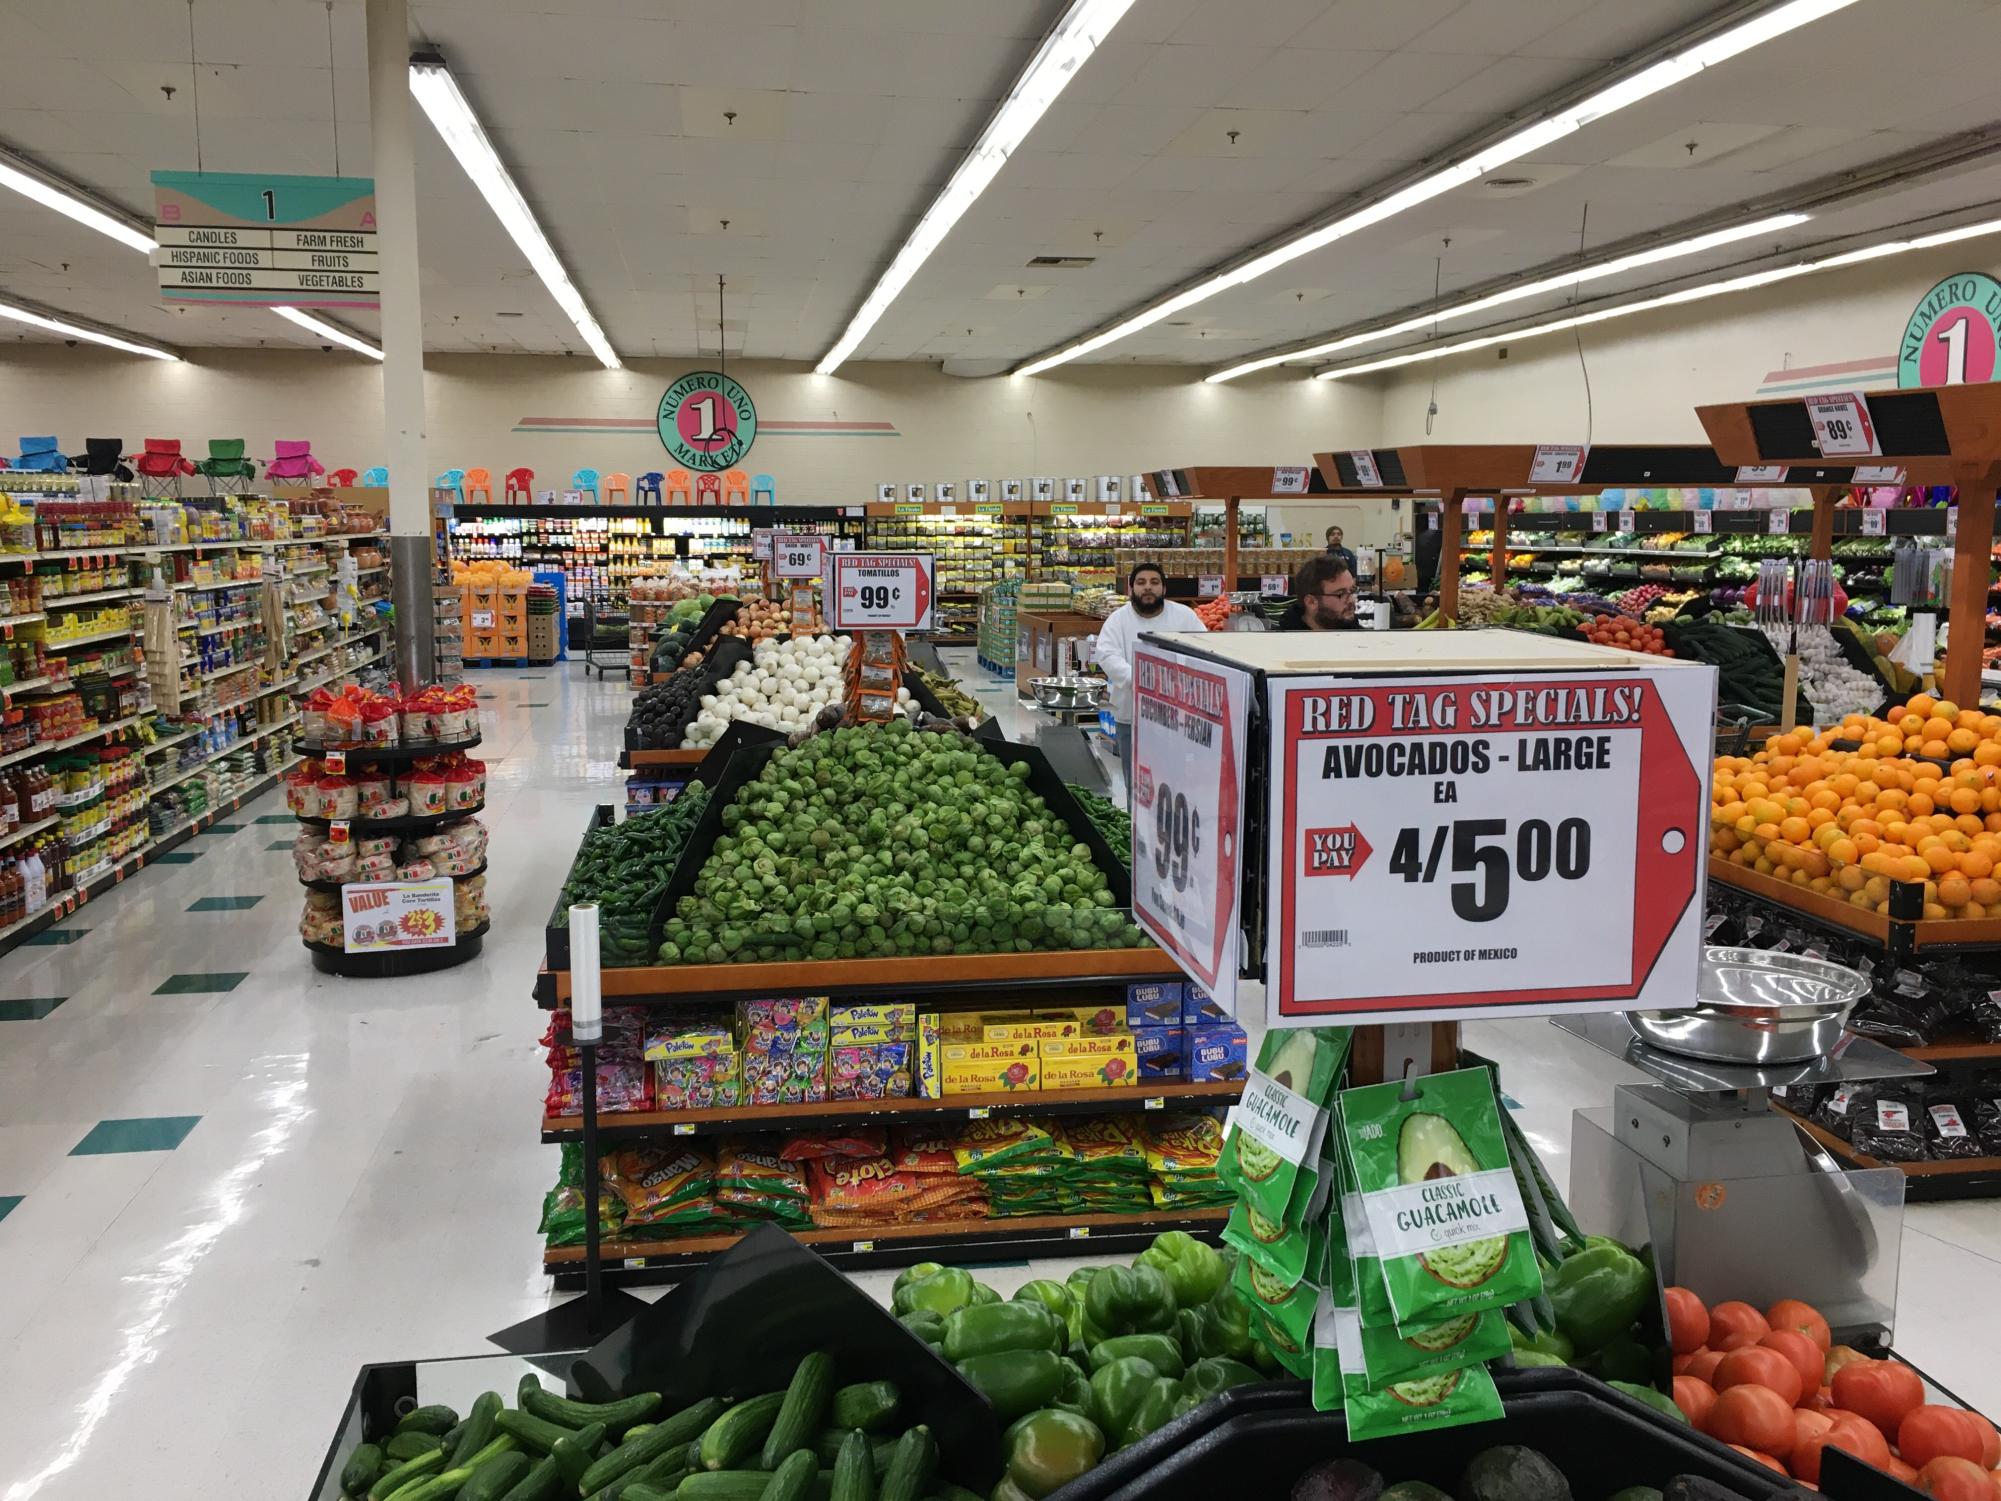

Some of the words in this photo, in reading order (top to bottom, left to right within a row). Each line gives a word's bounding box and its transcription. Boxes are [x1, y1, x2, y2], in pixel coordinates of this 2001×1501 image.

[162, 204, 181, 220] B
[262, 189, 275, 220] 1
[360, 211, 376, 226] A
[188, 231, 237, 244] CANDLES
[296, 234, 327, 247] FARM
[330, 235, 364, 248] FRESH
[171, 250, 220, 264] HISPANIC
[223, 252, 259, 264] FOODS
[311, 255, 349, 268] FRUITS
[180, 271, 213, 284] ASIAN
[216, 272, 252, 285] FOODS
[298, 274, 364, 288] VEGETABLES
[1904, 280, 1976, 364] NUMERO
[1937, 316, 1968, 385] 1
[663, 377, 719, 421] NUMERO
[726, 385, 752, 421] UNO
[690, 397, 724, 441] 1
[674, 443, 740, 467] MARKET
[842, 559, 858, 567] RED
[860, 559, 876, 567] TAG
[858, 569, 900, 577] TOMATILLOS
[1302, 694, 1375, 733] RED
[1388, 691, 1457, 730] TAG
[1470, 686, 1643, 727] SPECIALS!
[1322, 739, 1490, 780] AVOCADOS
[1517, 735, 1611, 772] LARGE
[1433, 781, 1458, 804] EA
[1312, 832, 1356, 850] YOU
[1312, 850, 1353, 870] PAY
[349, 891, 390, 913] VALUE
[1413, 950, 1460, 964] PRODUCT
[1463, 949, 1477, 962] OF
[1478, 948, 1518, 961] MEXICO
[1013, 1028, 1023, 1039] de
[1024, 1027, 1032, 1039] la
[1033, 1027, 1057, 1038] Rosa
[970, 1048, 980, 1059] de
[981, 1048, 989, 1058] la
[990, 1047, 1014, 1057] Rosa
[1068, 1043, 1079, 1054] de
[1079, 1043, 1087, 1053] la
[1088, 1042, 1112, 1052] Rosa
[1201, 1047, 1223, 1055] BUBU
[1202, 1052, 1224, 1061] LUBU
[945, 1074, 958, 1083] de
[959, 1074, 969, 1083] la
[970, 1074, 996, 1083] Rosa
[1044, 1071, 1056, 1080] de
[1058, 1070, 1068, 1079] la
[1069, 1070, 1095, 1079] Rosa
[1264, 1084, 1288, 1108] CLASSIC
[1246, 1091, 1300, 1138] GUACAMOLE
[642, 1152, 701, 1188] Mango
[737, 1152, 796, 1173] Mango
[836, 1158, 897, 1186] Elote
[1422, 1182, 1464, 1203] CLASSIC
[1397, 1194, 1502, 1231] GUACAMOLE
[1444, 1223, 1466, 1239] quick
